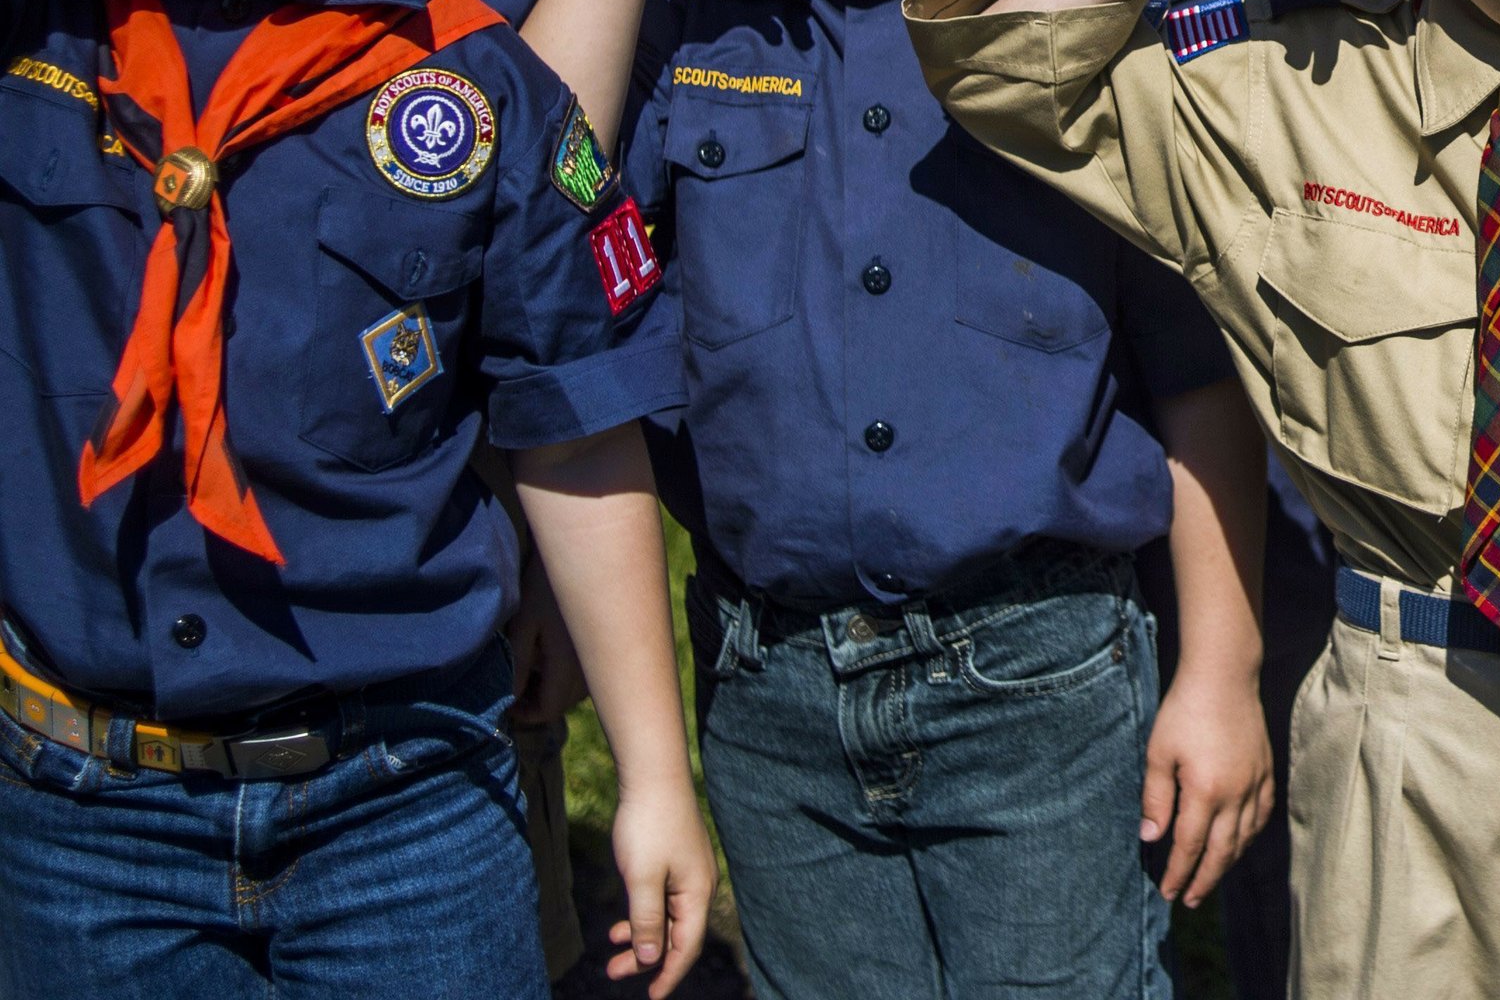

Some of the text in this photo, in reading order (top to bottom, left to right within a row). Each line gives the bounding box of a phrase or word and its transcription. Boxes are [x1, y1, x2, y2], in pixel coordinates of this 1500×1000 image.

[27, 61, 88, 98] SCOUTS
[673, 66, 802, 97] SCOUTS OF AMERICA
[374, 72, 491, 134] BOY SCOUTS OF AMERICA
[394, 169, 458, 193] SINCE 1910
[1304, 182, 1460, 236] BOY SCOUTS OF AMERICA
